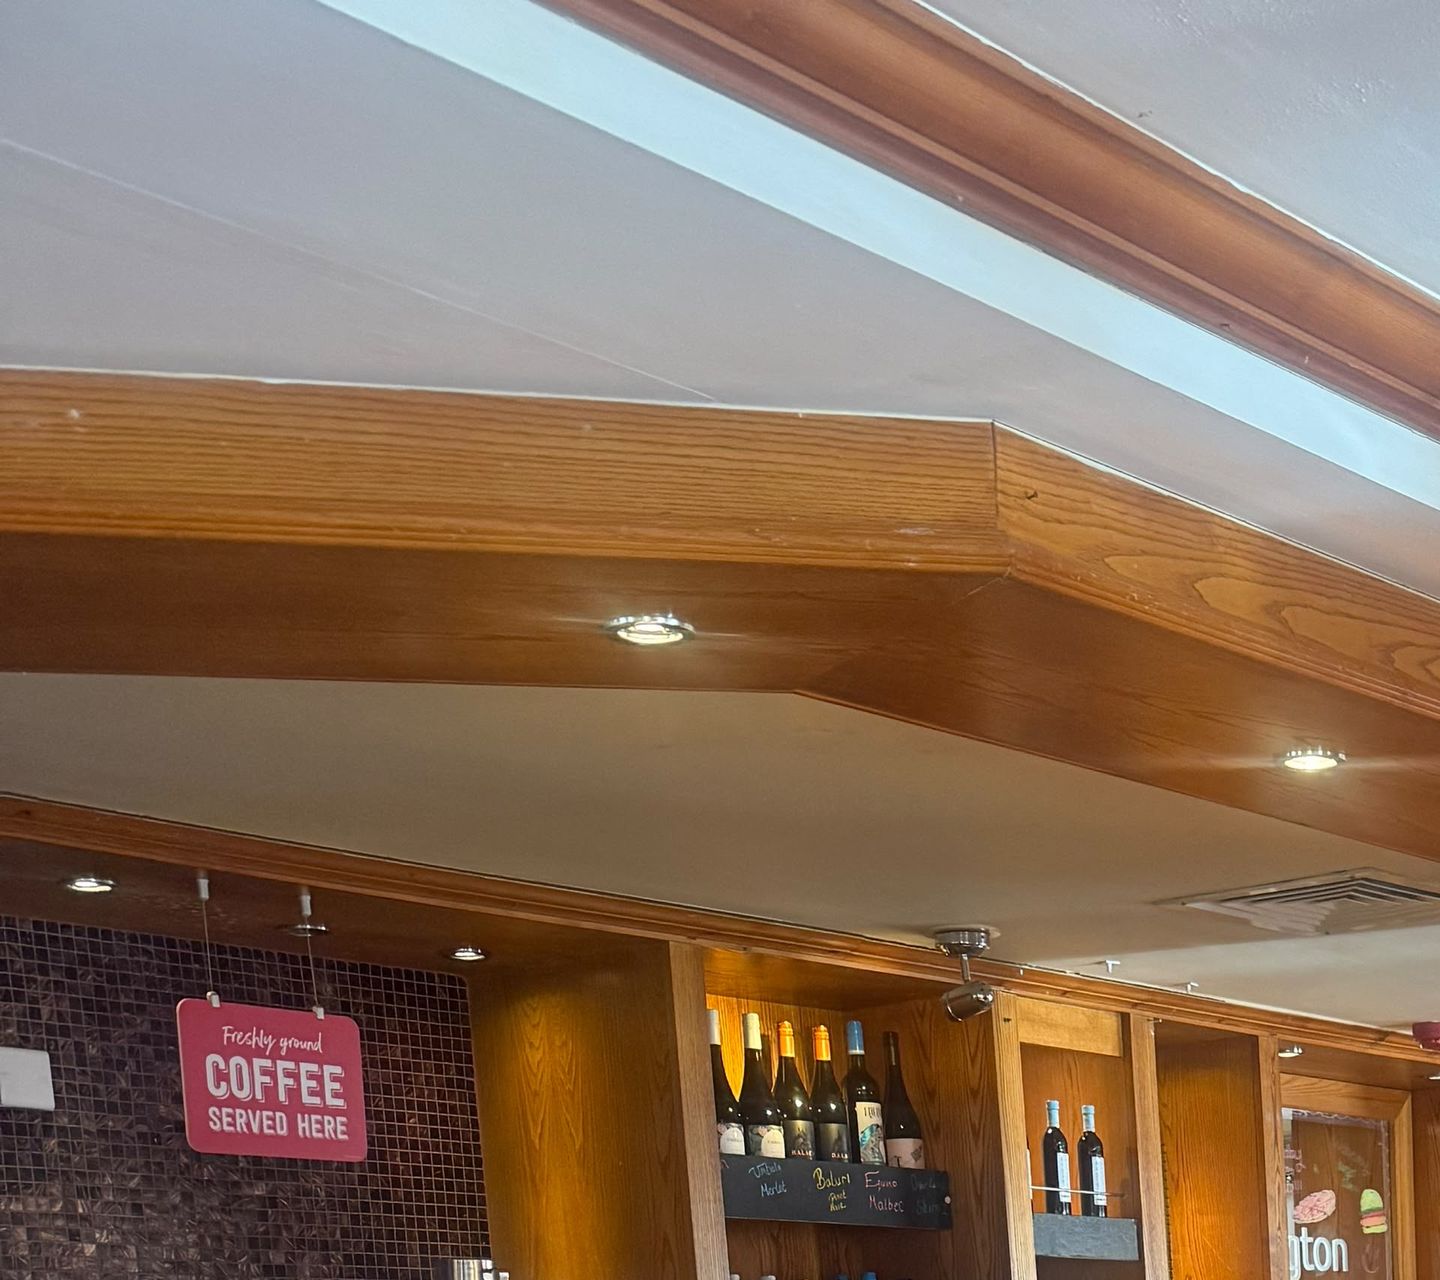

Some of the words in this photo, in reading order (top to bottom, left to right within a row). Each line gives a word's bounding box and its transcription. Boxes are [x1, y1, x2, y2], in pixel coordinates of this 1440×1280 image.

[222, 1026, 276, 1055] Freshly
[279, 1032, 323, 1055] ground
[205, 1053, 347, 1109] COFFEE
[208, 1106, 288, 1136] SERVED
[297, 1113, 349, 1140] HERE
[869, 1194, 905, 1213] Malbec
